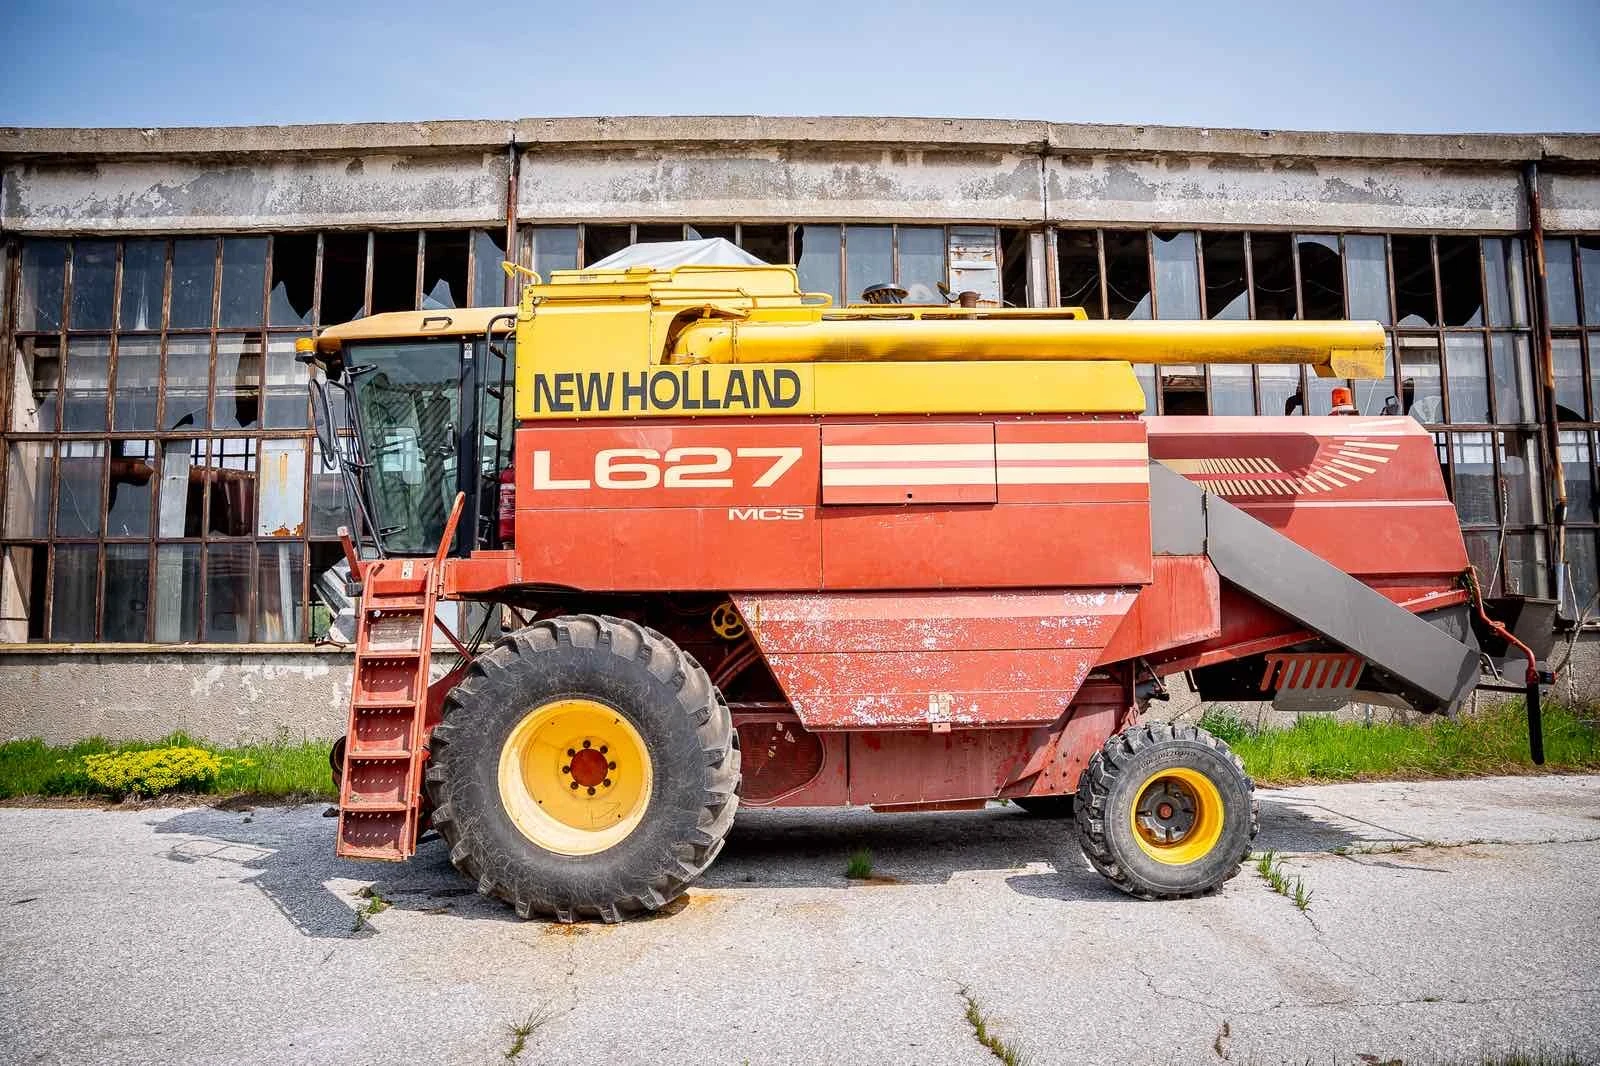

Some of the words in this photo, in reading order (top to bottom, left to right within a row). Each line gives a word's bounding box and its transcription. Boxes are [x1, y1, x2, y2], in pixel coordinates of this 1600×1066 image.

[534, 372, 614, 412] NEW
[623, 370, 801, 410] HOLLAND
[533, 447, 803, 489] L627
[728, 508, 804, 521] MCS
